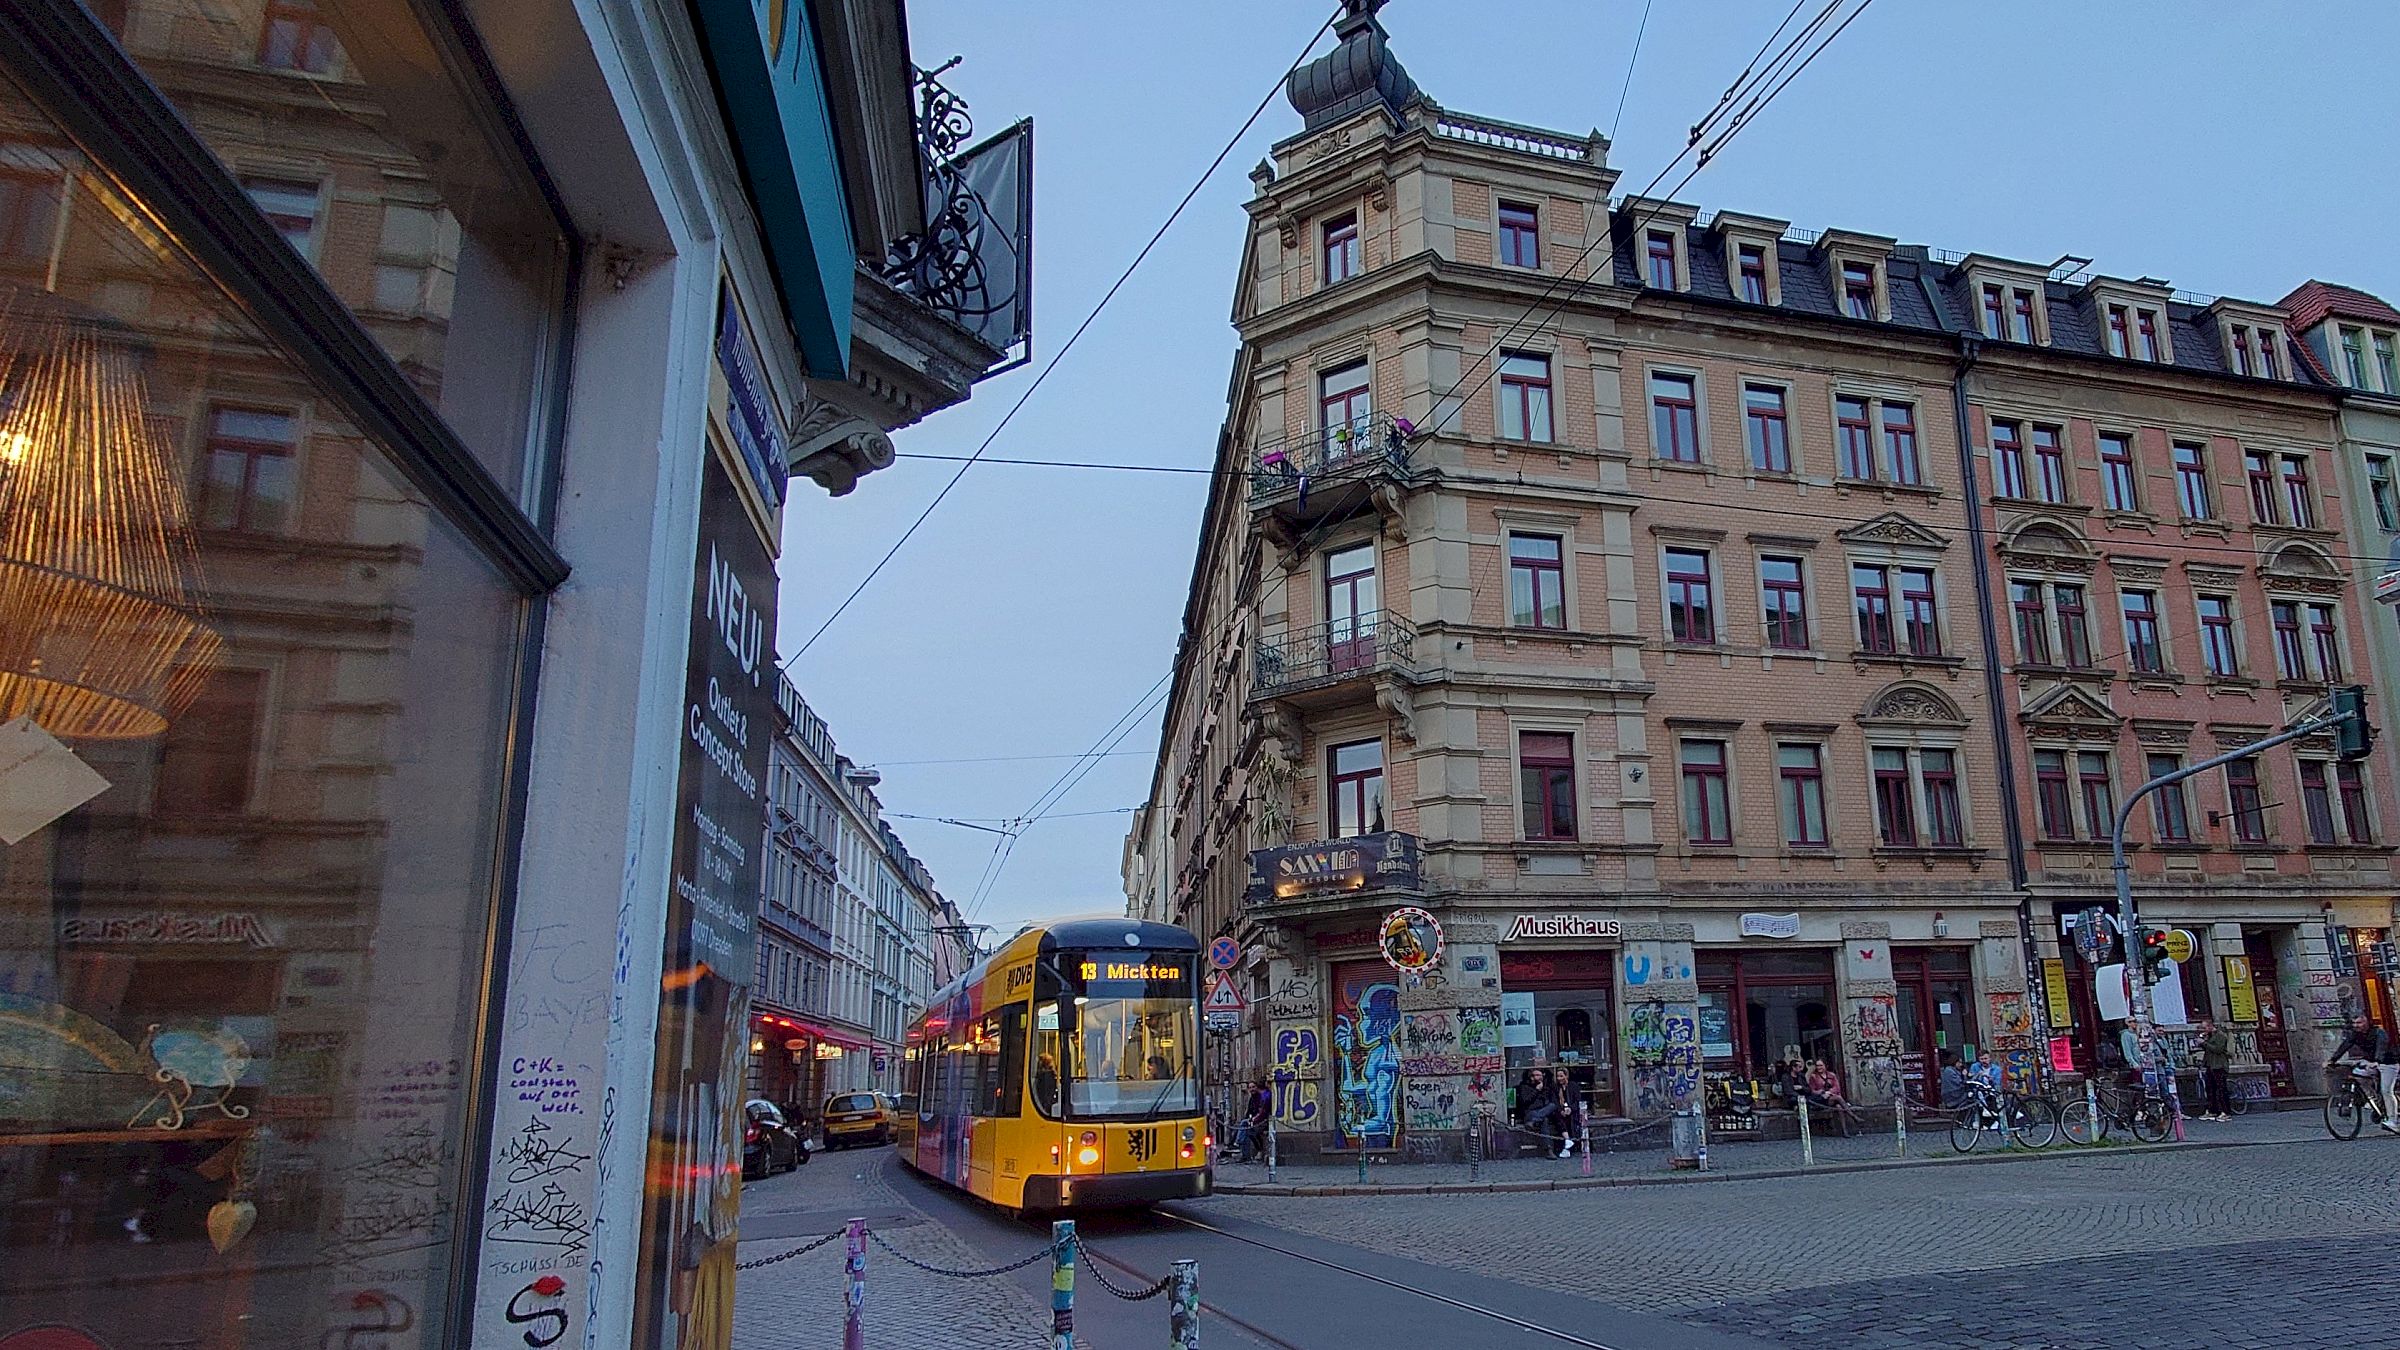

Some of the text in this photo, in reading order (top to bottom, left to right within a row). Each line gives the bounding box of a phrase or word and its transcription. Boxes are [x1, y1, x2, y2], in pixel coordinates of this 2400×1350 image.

[706, 540, 764, 688] NEU!
[709, 676, 748, 749] Outlet &
[690, 703, 756, 800] Concept Store
[693, 803, 718, 845] Montag
[721, 826, 745, 867] Samstag
[1287, 841, 1309, 851] ENJOY
[1311, 840, 1325, 848] THE
[721, 857, 733, 885] Uhr
[709, 927, 732, 956] Dresden
[1506, 915, 1620, 940] Musikhaus
[1015, 963, 1033, 986] DVB
[1079, 962, 1180, 981] 13 Mickten
[519, 1089, 545, 1103] auf
